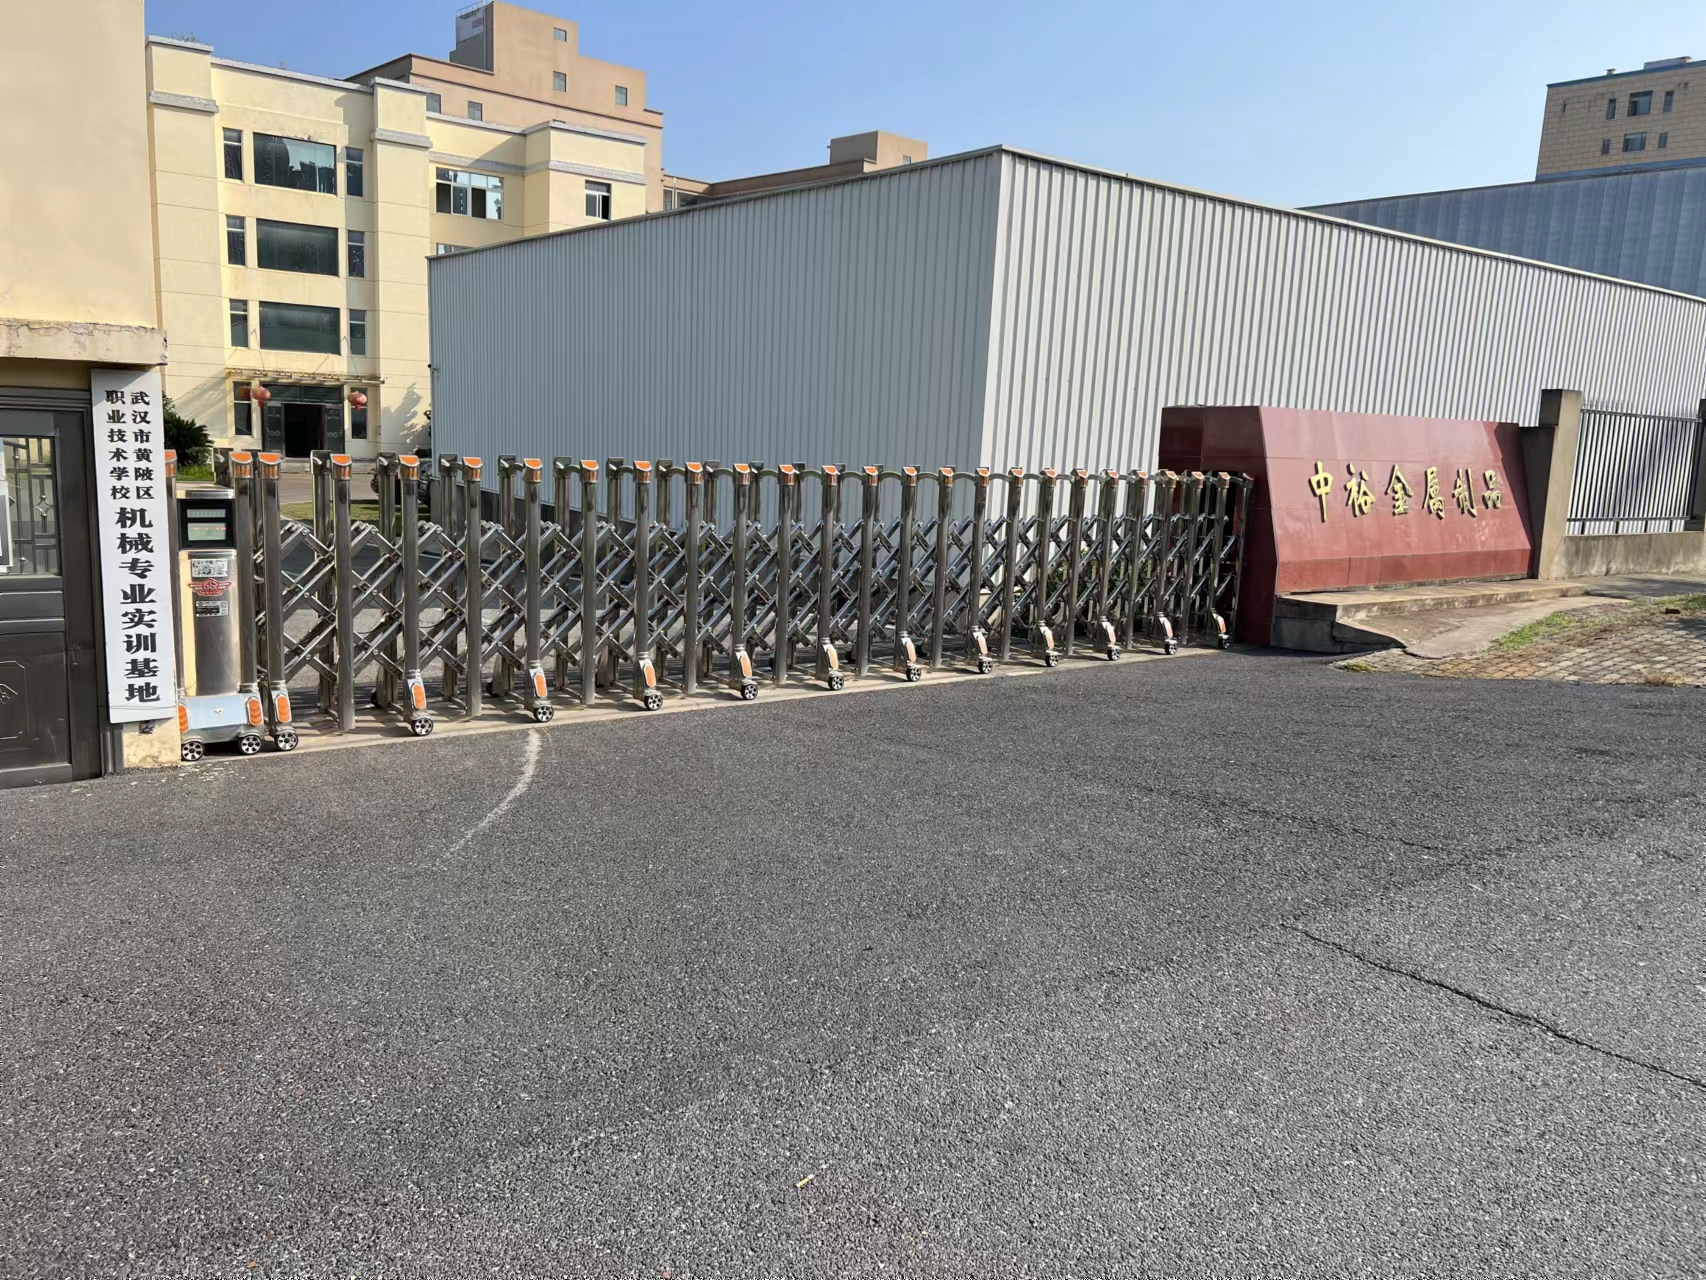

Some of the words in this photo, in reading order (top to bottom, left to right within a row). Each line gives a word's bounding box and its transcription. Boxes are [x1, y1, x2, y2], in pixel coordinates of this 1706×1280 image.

[104, 389, 131, 500] 职业技术学校
[130, 390, 155, 500] 武汉市黄陂区
[115, 507, 160, 703] 机械专业实训基地
